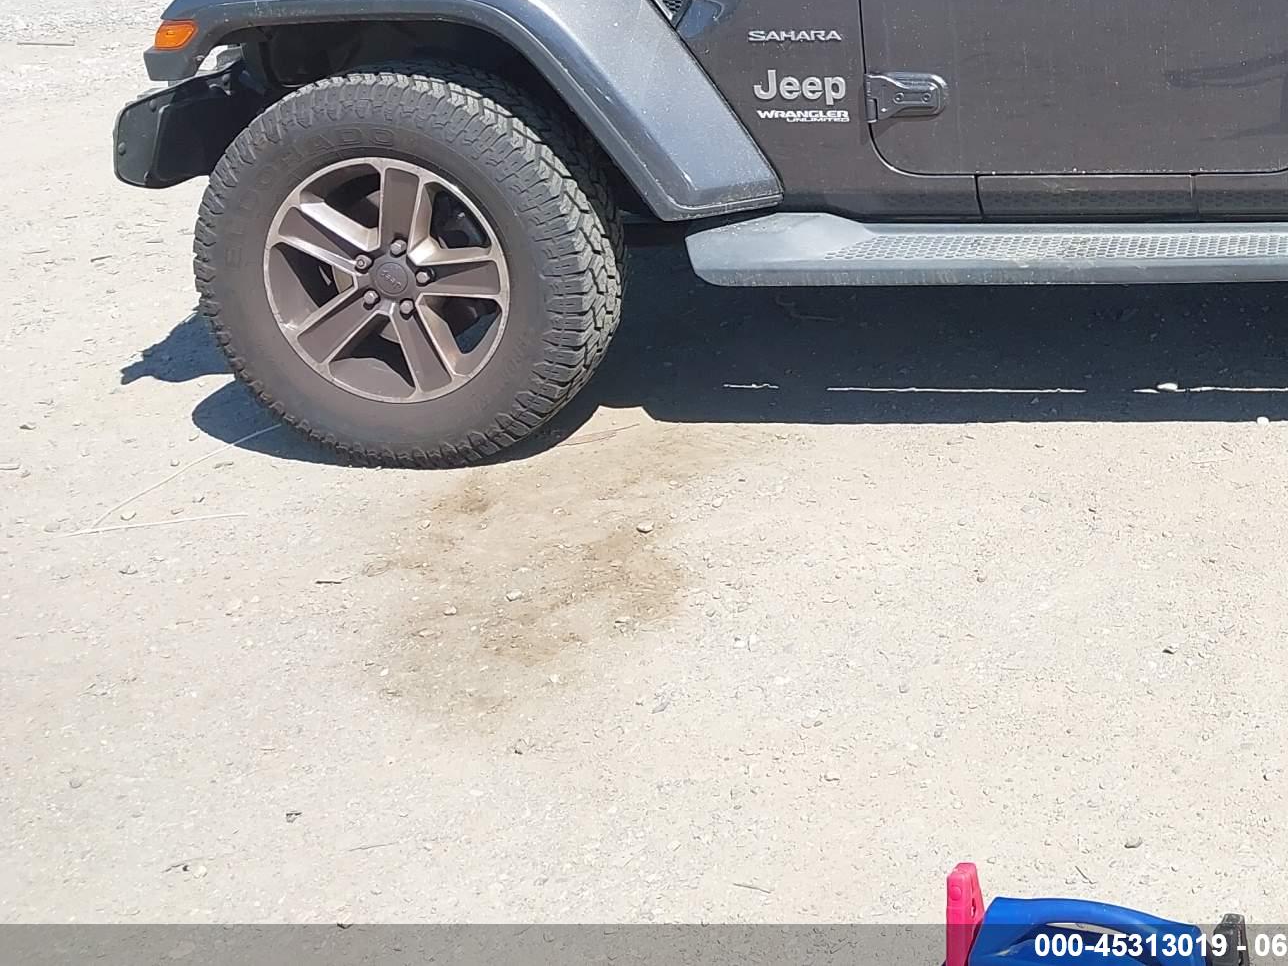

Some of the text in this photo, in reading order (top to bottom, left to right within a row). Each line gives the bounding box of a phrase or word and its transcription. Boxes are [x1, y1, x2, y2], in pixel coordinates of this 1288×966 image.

[748, 30, 842, 42] SAHARA
[753, 69, 846, 106] Jeep
[757, 109, 849, 119] WRANGLER
